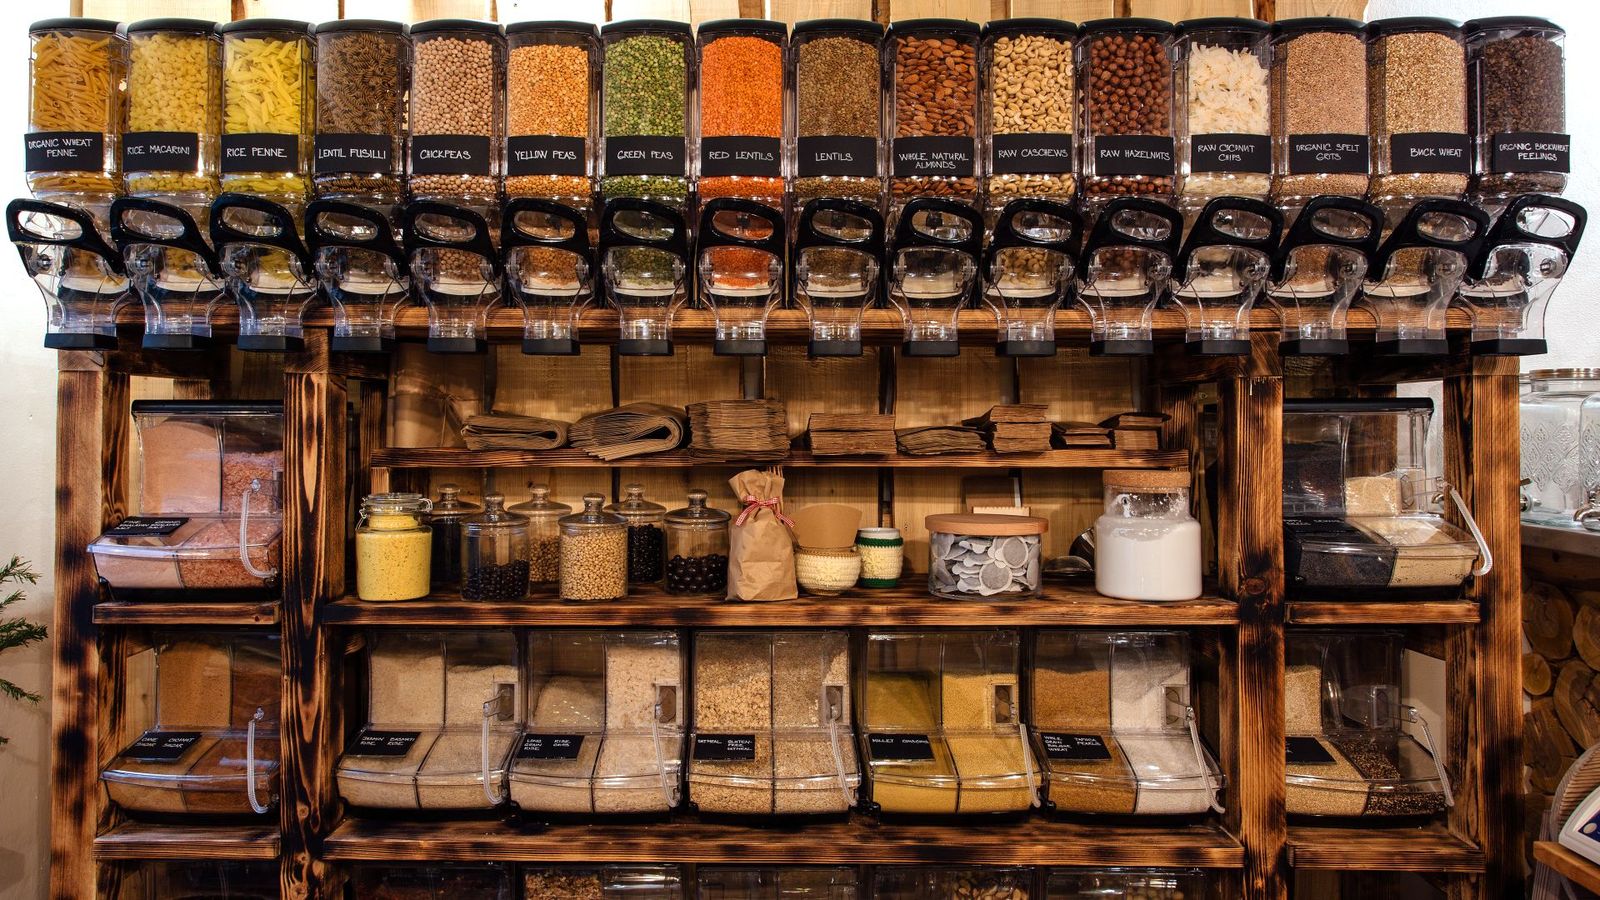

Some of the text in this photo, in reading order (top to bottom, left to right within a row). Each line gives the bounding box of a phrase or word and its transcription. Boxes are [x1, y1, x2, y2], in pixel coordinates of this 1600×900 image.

[128, 146, 145, 154] RICE
[1198, 144, 1216, 152] RAW
[1334, 144, 1359, 154] SPELT
[1499, 143, 1532, 151] ORGANIC
[47, 149, 77, 157] PENNE
[227, 147, 287, 157] RICE PENNE
[319, 148, 385, 159] LENTIL FUSILLI
[420, 150, 471, 159] CHICKPEAS
[515, 150, 576, 161] YELLOW PEAS
[617, 150, 673, 159] GREEN PEAS
[709, 151, 773, 160] RED LENTILS
[816, 152, 853, 161] LENTILS
[999, 150, 1017, 158] RAW
[1101, 150, 1120, 158] RAW
[1439, 148, 1462, 157] WHEAT
[1518, 152, 1557, 161] PEELINGS
[932, 153, 968, 162] NATURAL
